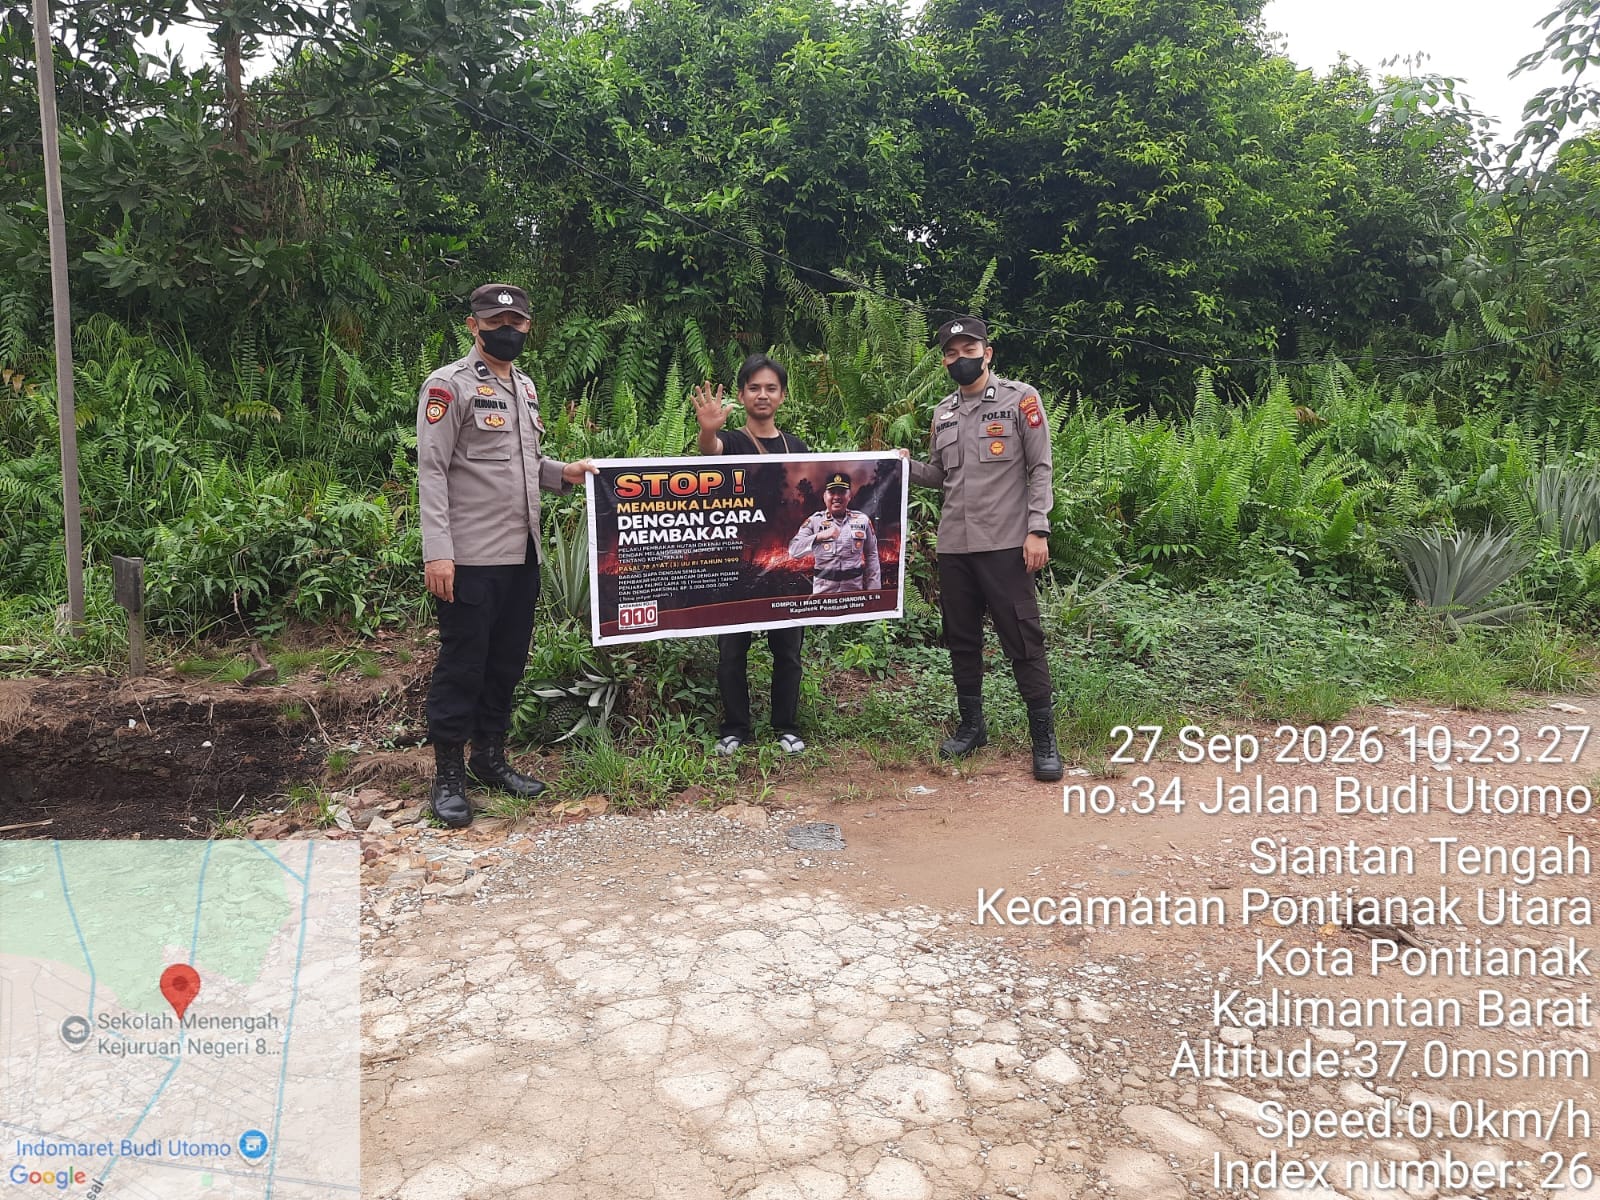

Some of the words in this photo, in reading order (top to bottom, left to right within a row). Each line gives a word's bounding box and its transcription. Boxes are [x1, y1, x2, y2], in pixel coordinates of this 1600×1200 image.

[982, 410, 1011, 421] POLRI
[615, 471, 724, 498] STOP
[617, 500, 699, 514] MEMBUKA
[703, 497, 754, 510] LAHAN
[617, 511, 704, 530] DENGAN
[709, 509, 767, 526] CARA
[618, 525, 738, 546] MEMBAKAR
[618, 564, 641, 572] PASAL
[771, 600, 799, 609] KOMPOL
[804, 598, 821, 606] MADE
[822, 597, 838, 605] ARIS
[789, 605, 818, 614] Kapolsek
[819, 602, 849, 611] Pontianak
[621, 608, 656, 624] 110
